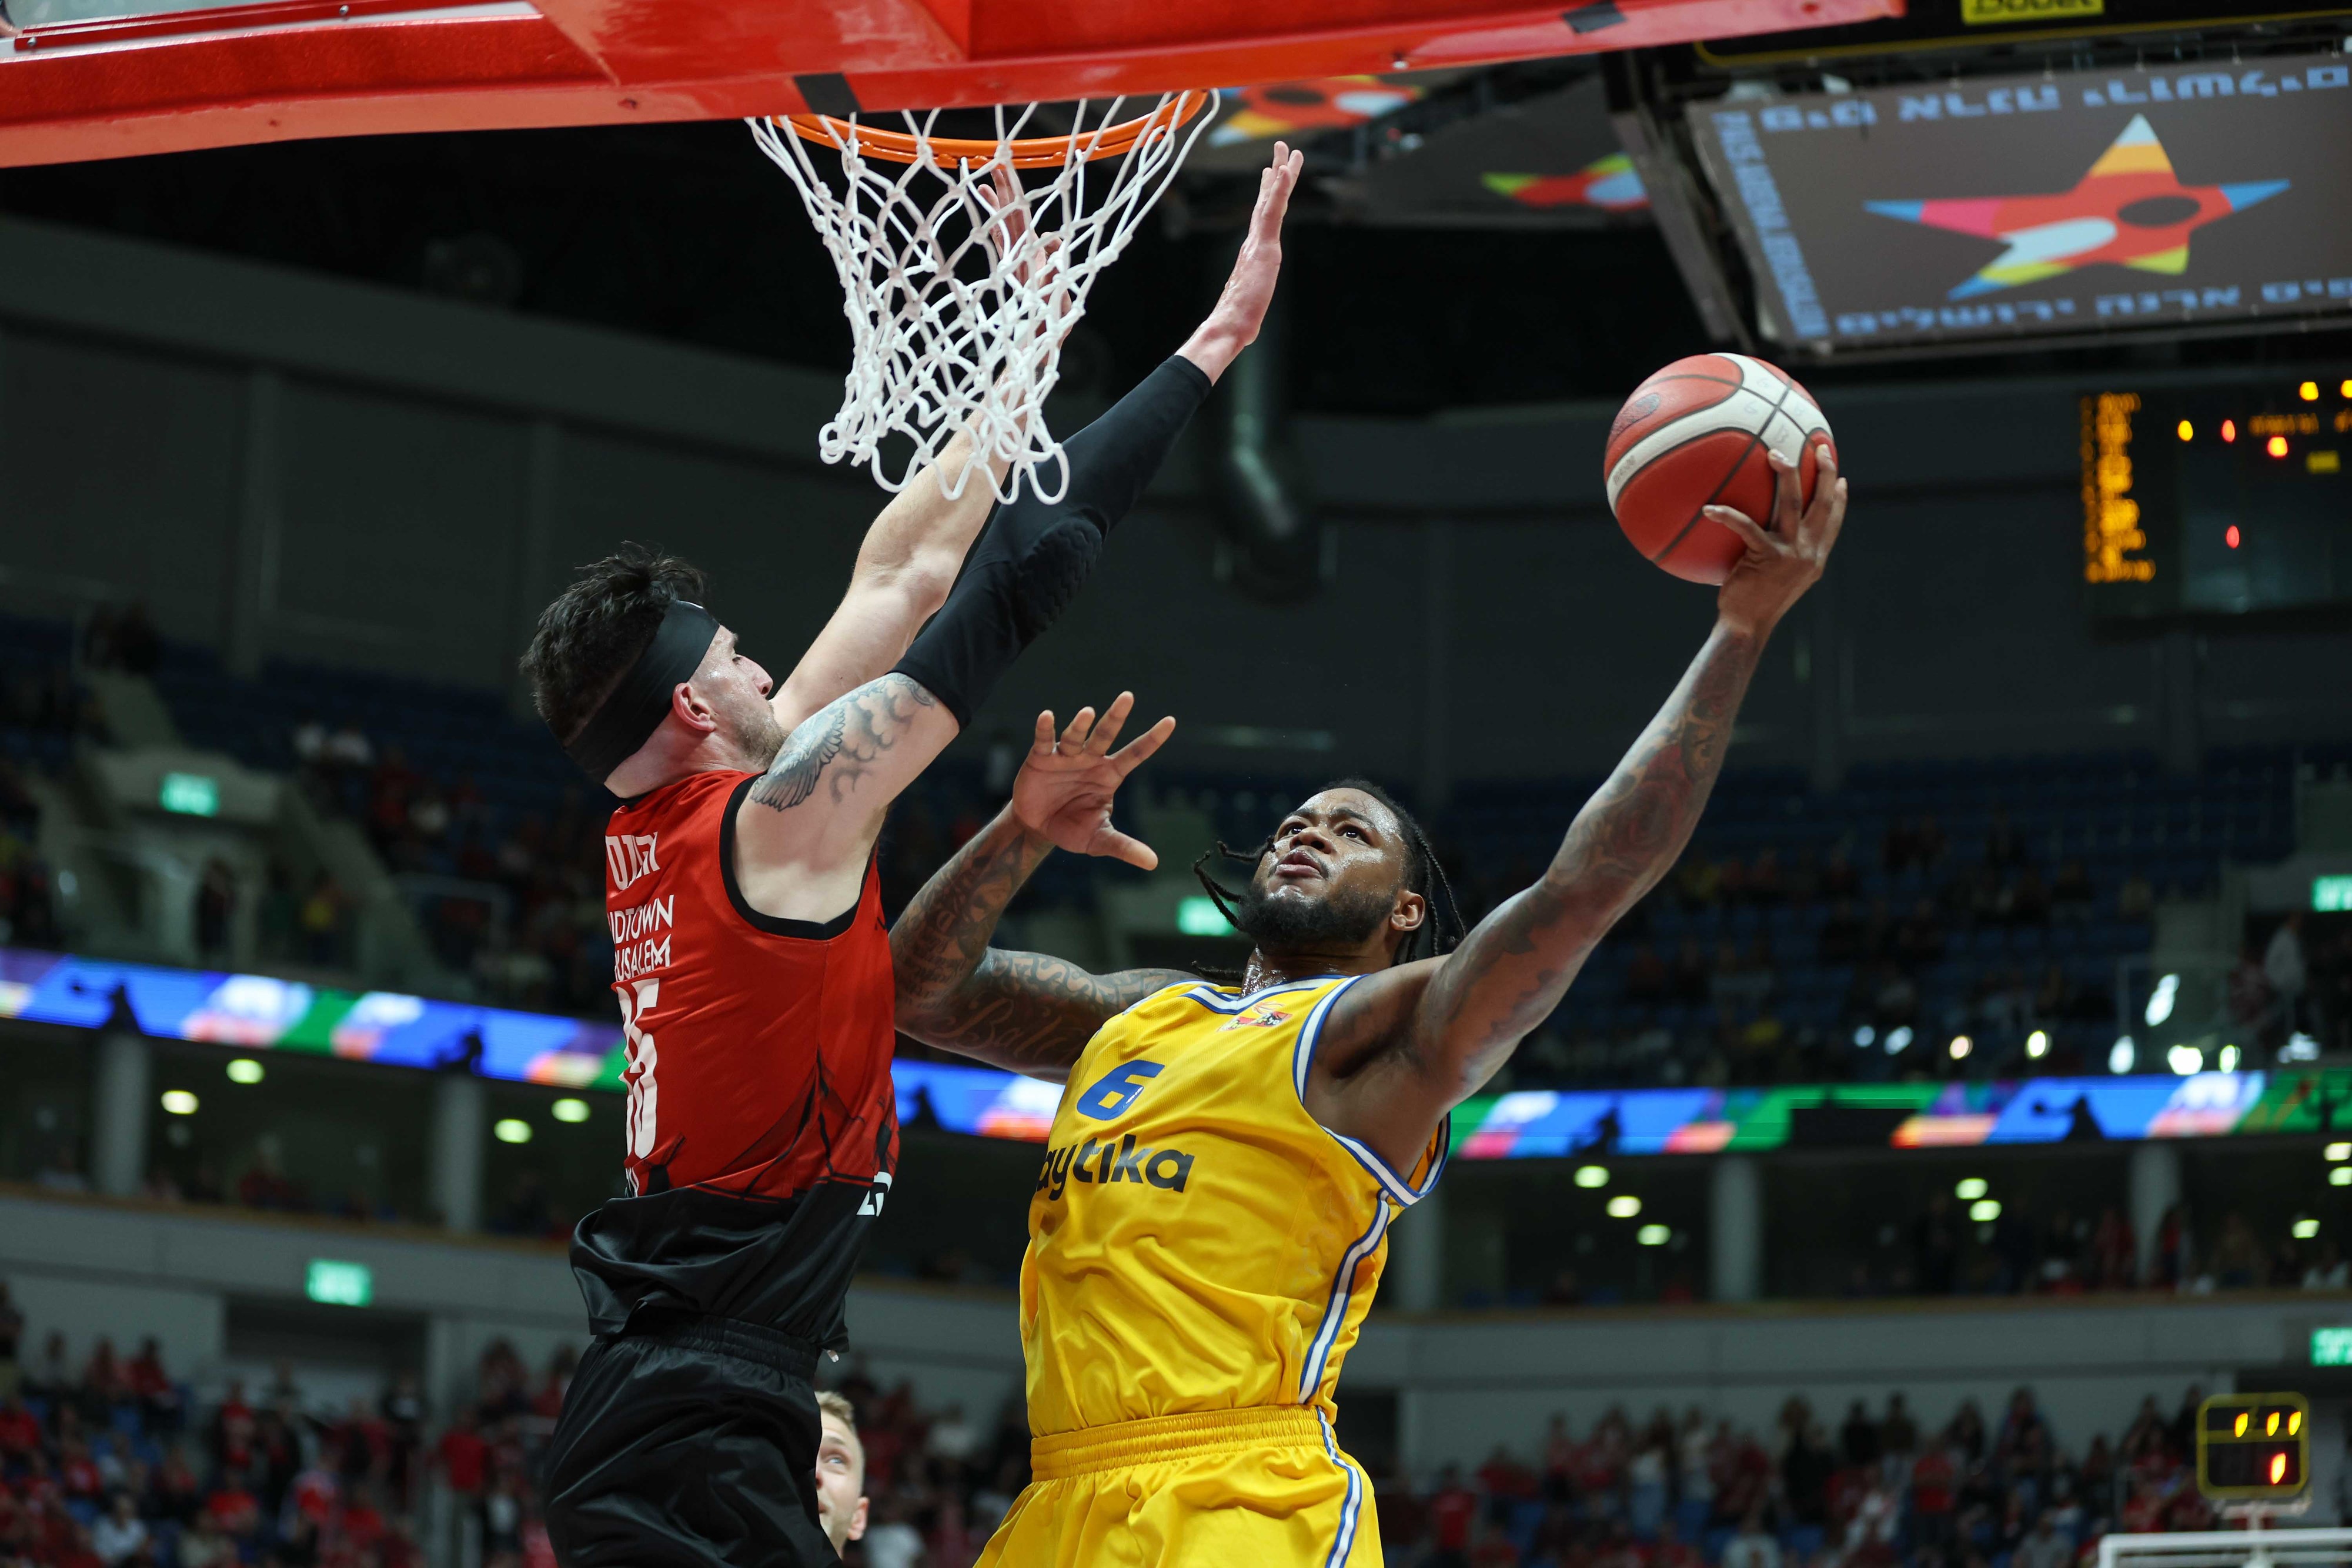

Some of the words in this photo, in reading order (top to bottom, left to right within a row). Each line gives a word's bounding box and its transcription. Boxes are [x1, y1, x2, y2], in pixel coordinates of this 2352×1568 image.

[607, 894, 674, 944] IDTOWN
[614, 934, 671, 982] USALEM
[1077, 1059, 1165, 1121] 6
[1036, 1134, 1195, 1201] aytika
